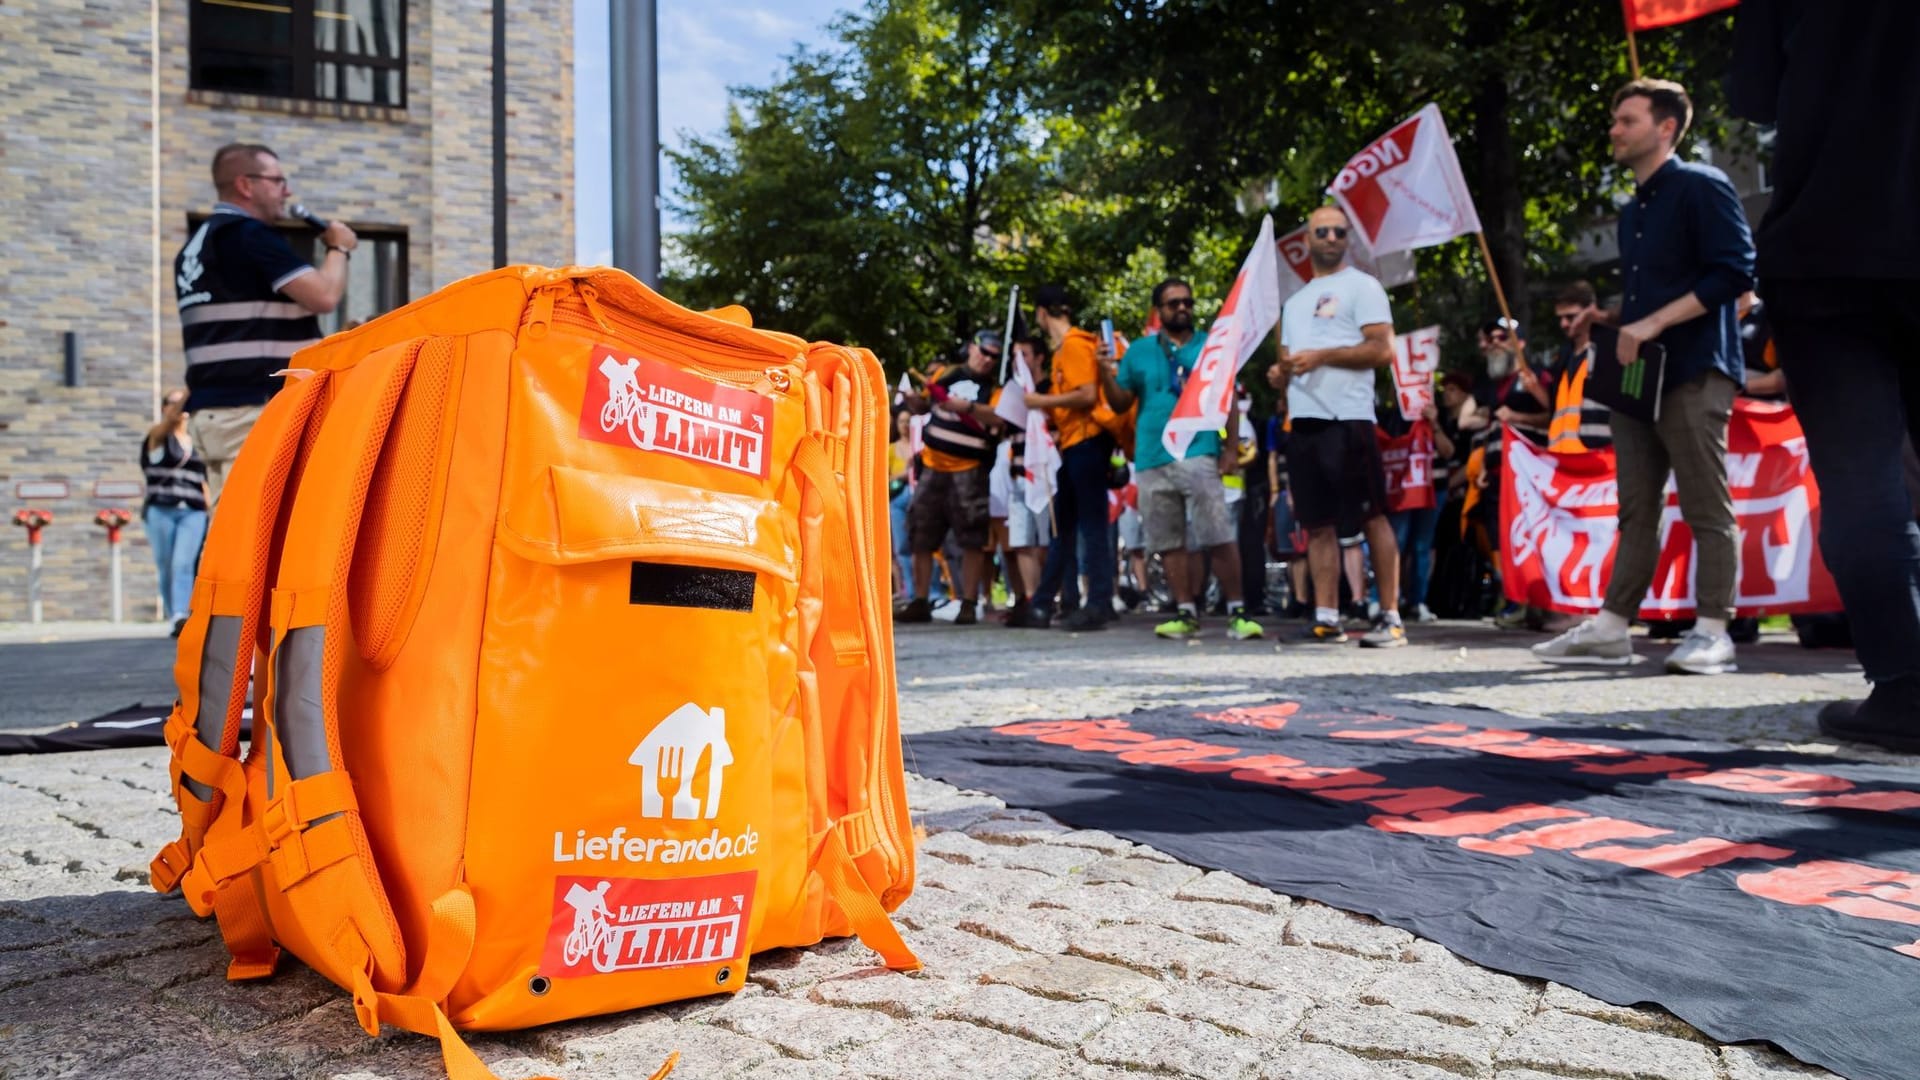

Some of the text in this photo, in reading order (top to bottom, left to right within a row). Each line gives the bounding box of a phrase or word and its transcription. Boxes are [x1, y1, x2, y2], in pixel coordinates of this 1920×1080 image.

[648, 384, 742, 425] LIEFERN AM
[653, 411, 757, 469] LIMIT
[553, 824, 759, 864] Lieferando.de
[618, 898, 722, 923] LIEFERN AM
[615, 921, 734, 965] LIMIT
